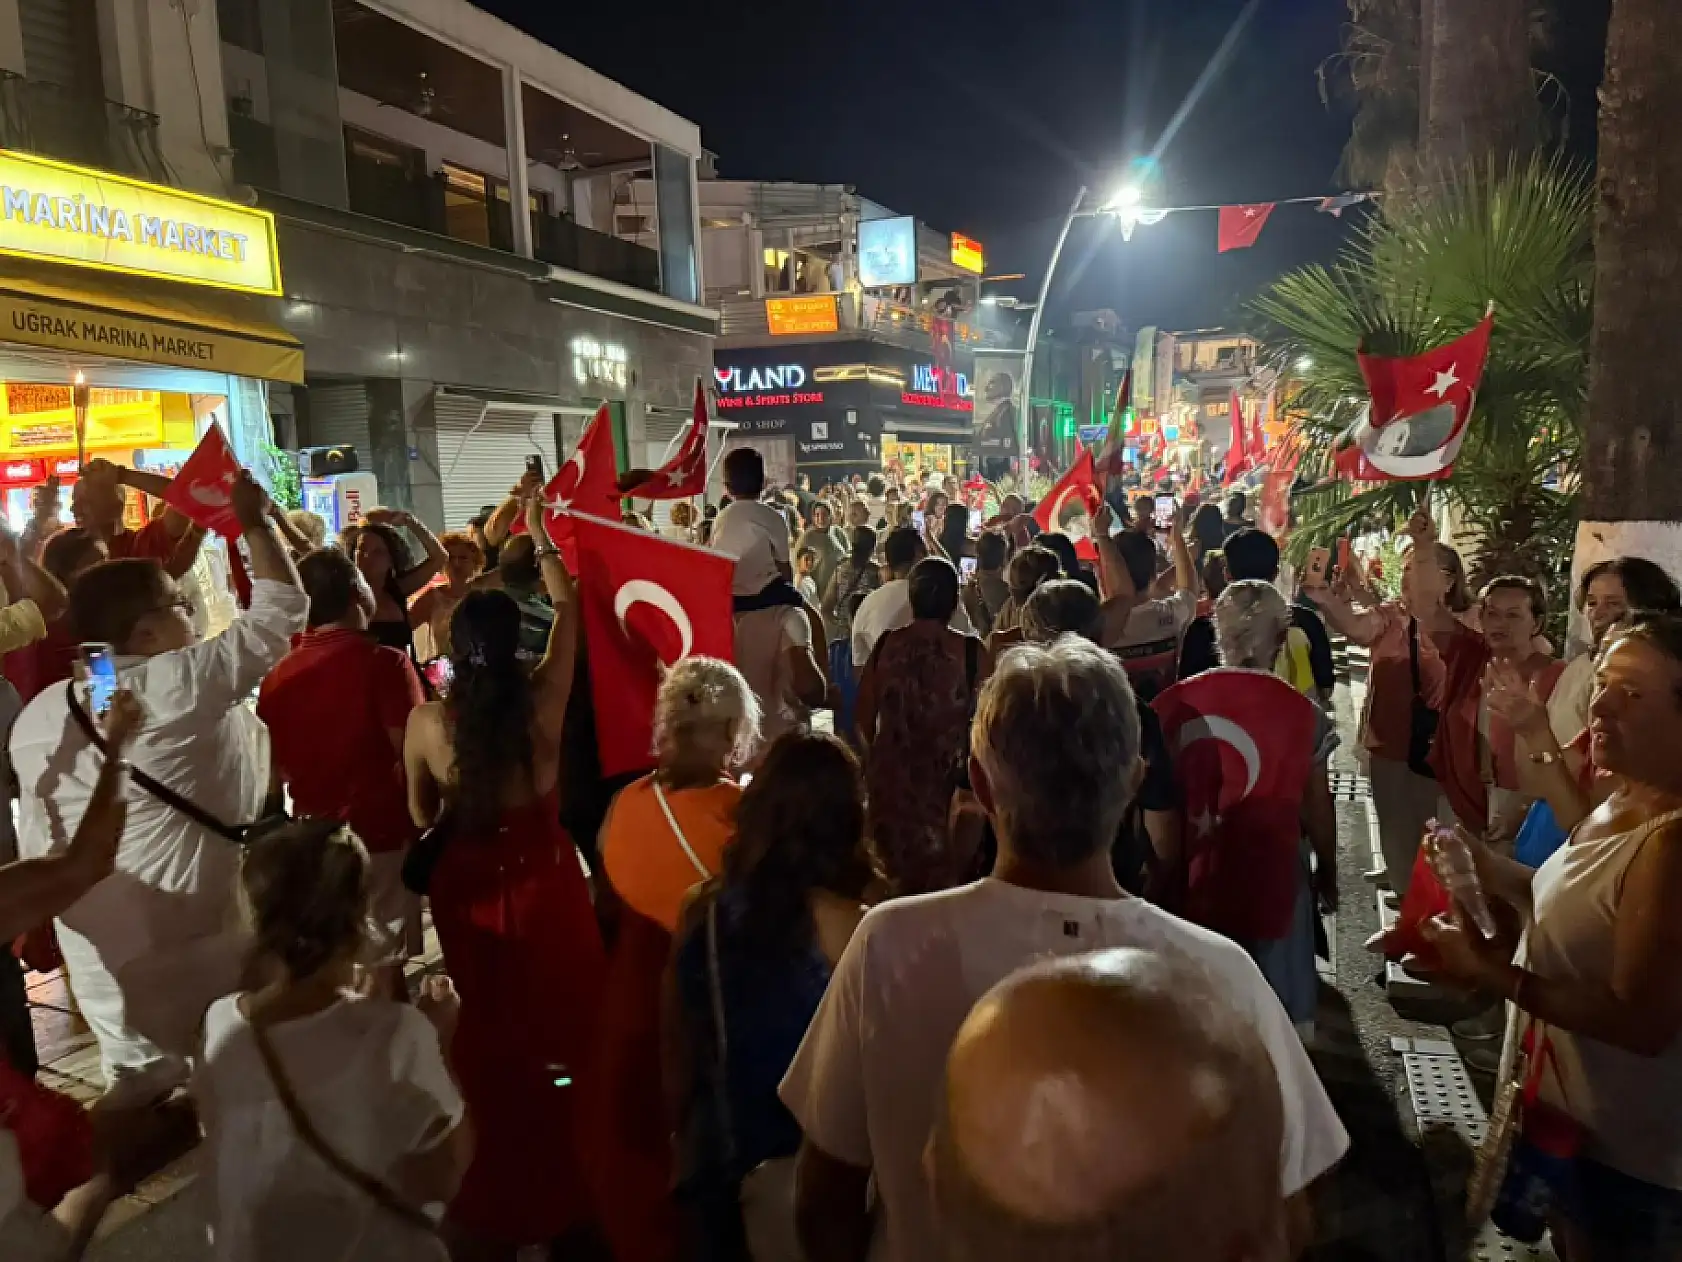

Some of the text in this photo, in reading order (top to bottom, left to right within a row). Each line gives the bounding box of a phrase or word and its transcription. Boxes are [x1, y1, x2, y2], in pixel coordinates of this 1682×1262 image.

[134, 213, 248, 262] MARKET
[12, 308, 79, 339] UĞRAK
[152, 335, 215, 361] MARKET
[713, 365, 807, 392] YLAND
[912, 363, 968, 397] MEYD
[792, 391, 824, 404] STORE
